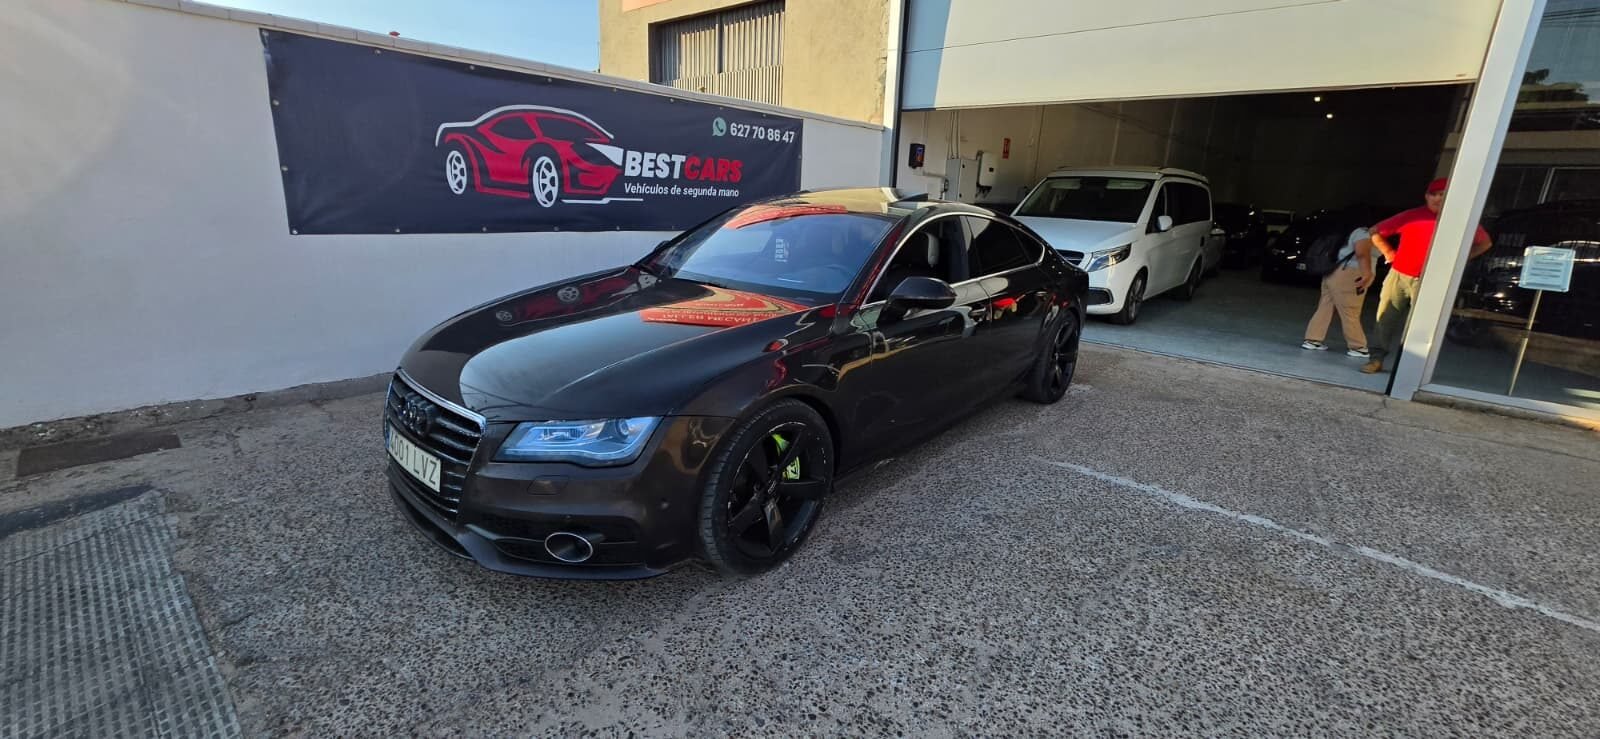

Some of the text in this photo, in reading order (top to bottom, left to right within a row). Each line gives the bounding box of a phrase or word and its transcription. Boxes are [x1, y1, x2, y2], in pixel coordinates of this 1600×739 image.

[730, 122, 795, 143] 627 70 86 47
[624, 183, 740, 198] Vehículos de segunda mano
[413, 449, 437, 485] LVZ
